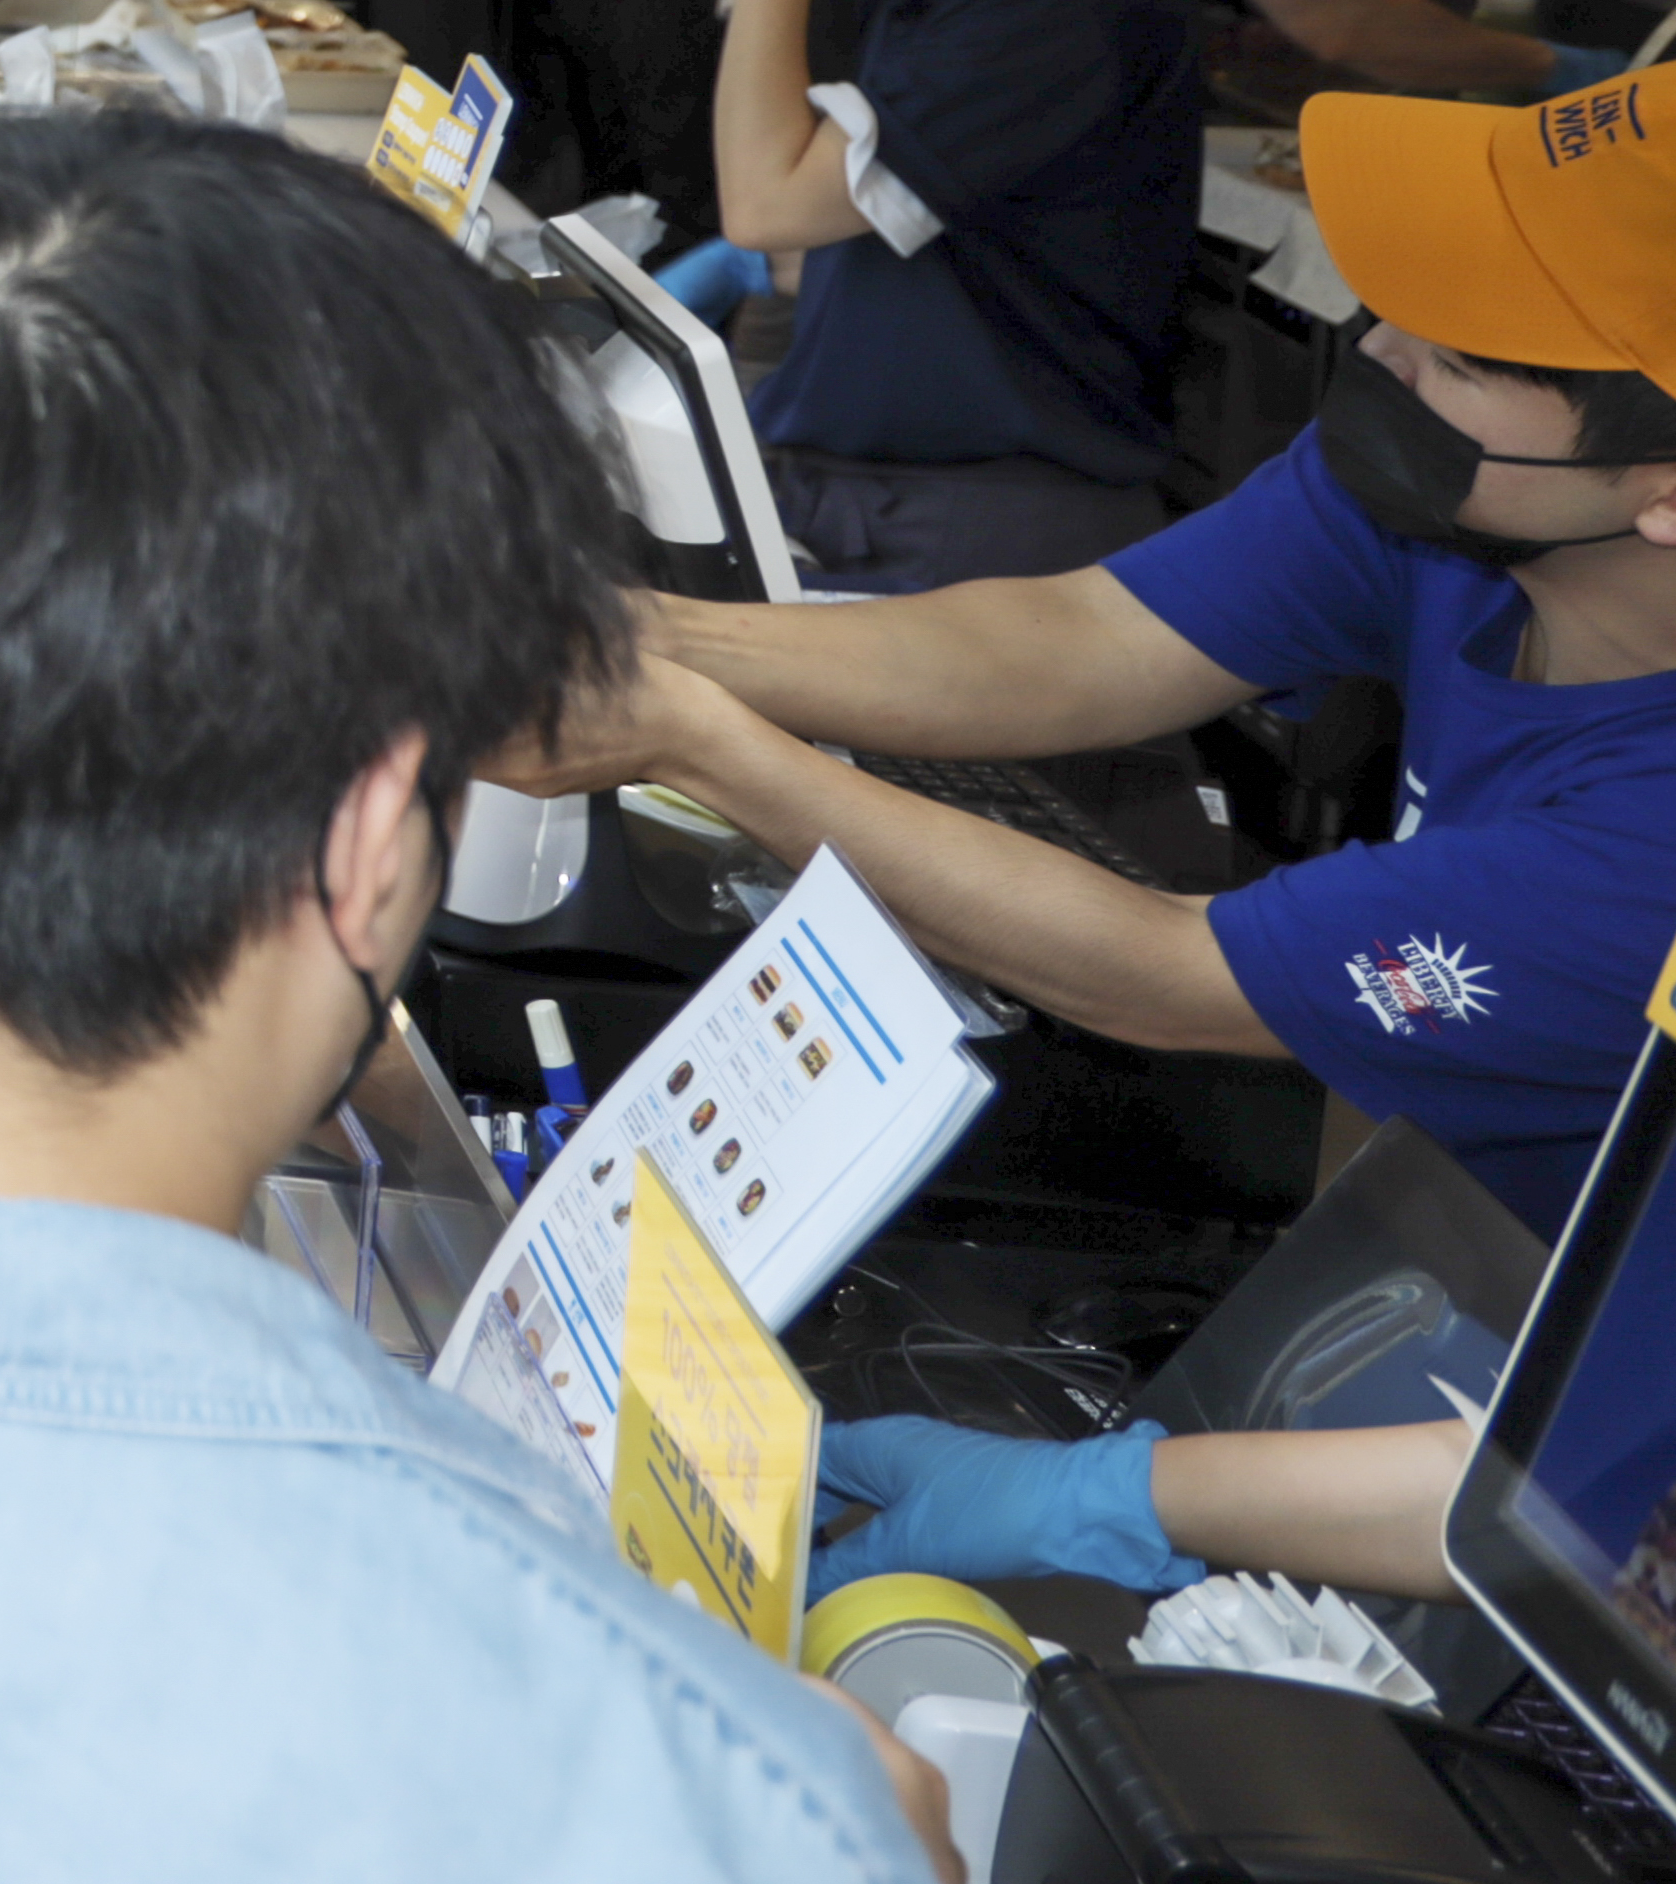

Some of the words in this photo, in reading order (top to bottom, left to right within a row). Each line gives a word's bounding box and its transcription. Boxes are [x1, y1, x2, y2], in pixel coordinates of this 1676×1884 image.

[1554, 99, 1593, 161] WICH
[1353, 953, 1416, 1035] BEVERAGES
[1397, 942, 1460, 1019] LIBERTY
[663, 1307, 719, 1444] 100%
